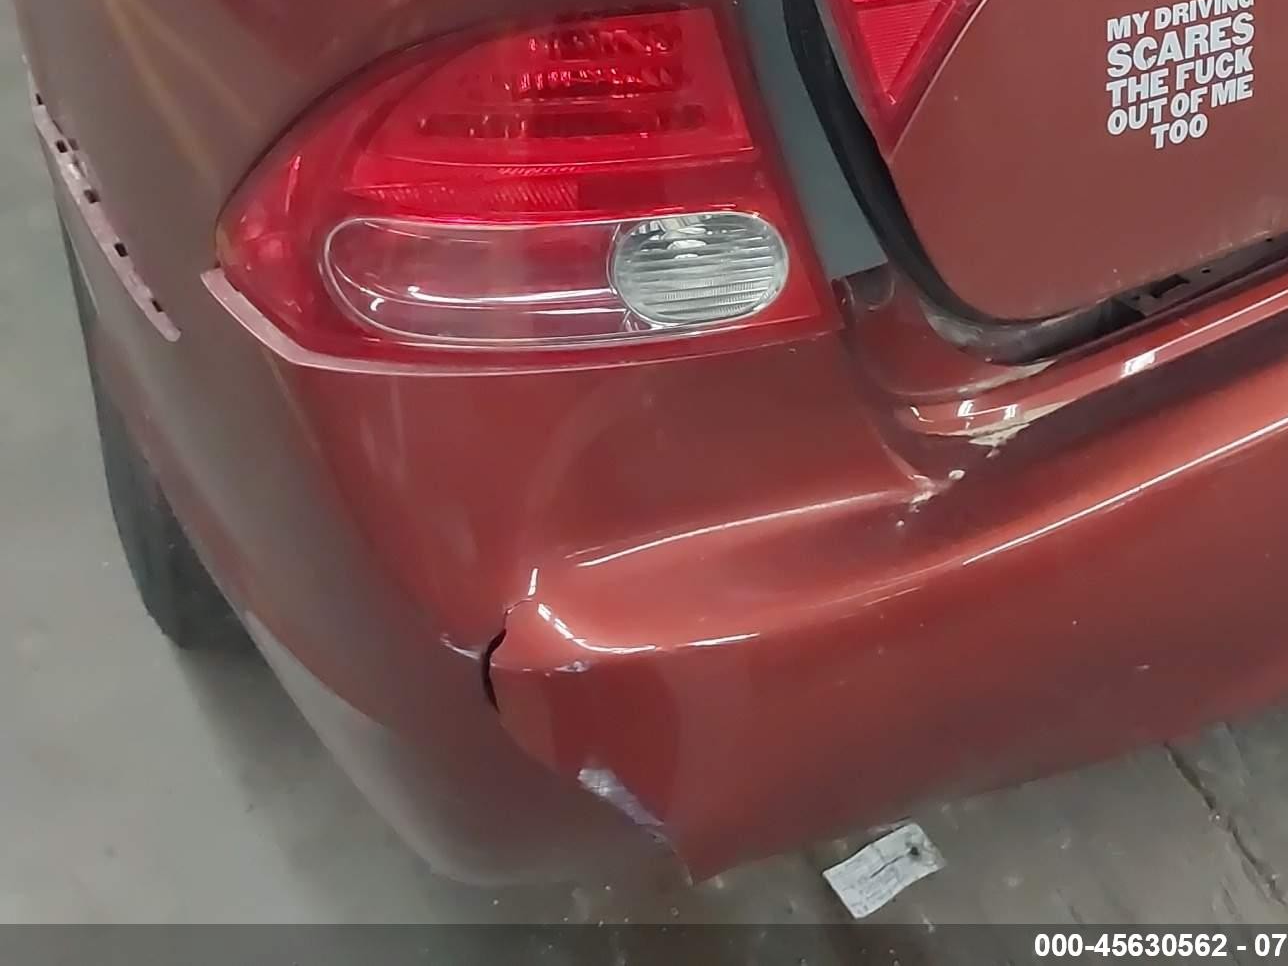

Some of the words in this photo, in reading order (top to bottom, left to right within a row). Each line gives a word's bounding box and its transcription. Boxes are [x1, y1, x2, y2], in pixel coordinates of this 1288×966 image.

[1107, 10, 1150, 42] MY
[1107, 11, 1255, 78] SCARES
[1105, 68, 1169, 108] THE
[1175, 45, 1254, 91] FUCK
[1106, 97, 1168, 136] OUT
[1170, 86, 1208, 118] OF
[1211, 74, 1254, 108] ME
[1151, 113, 1208, 149] TOO
